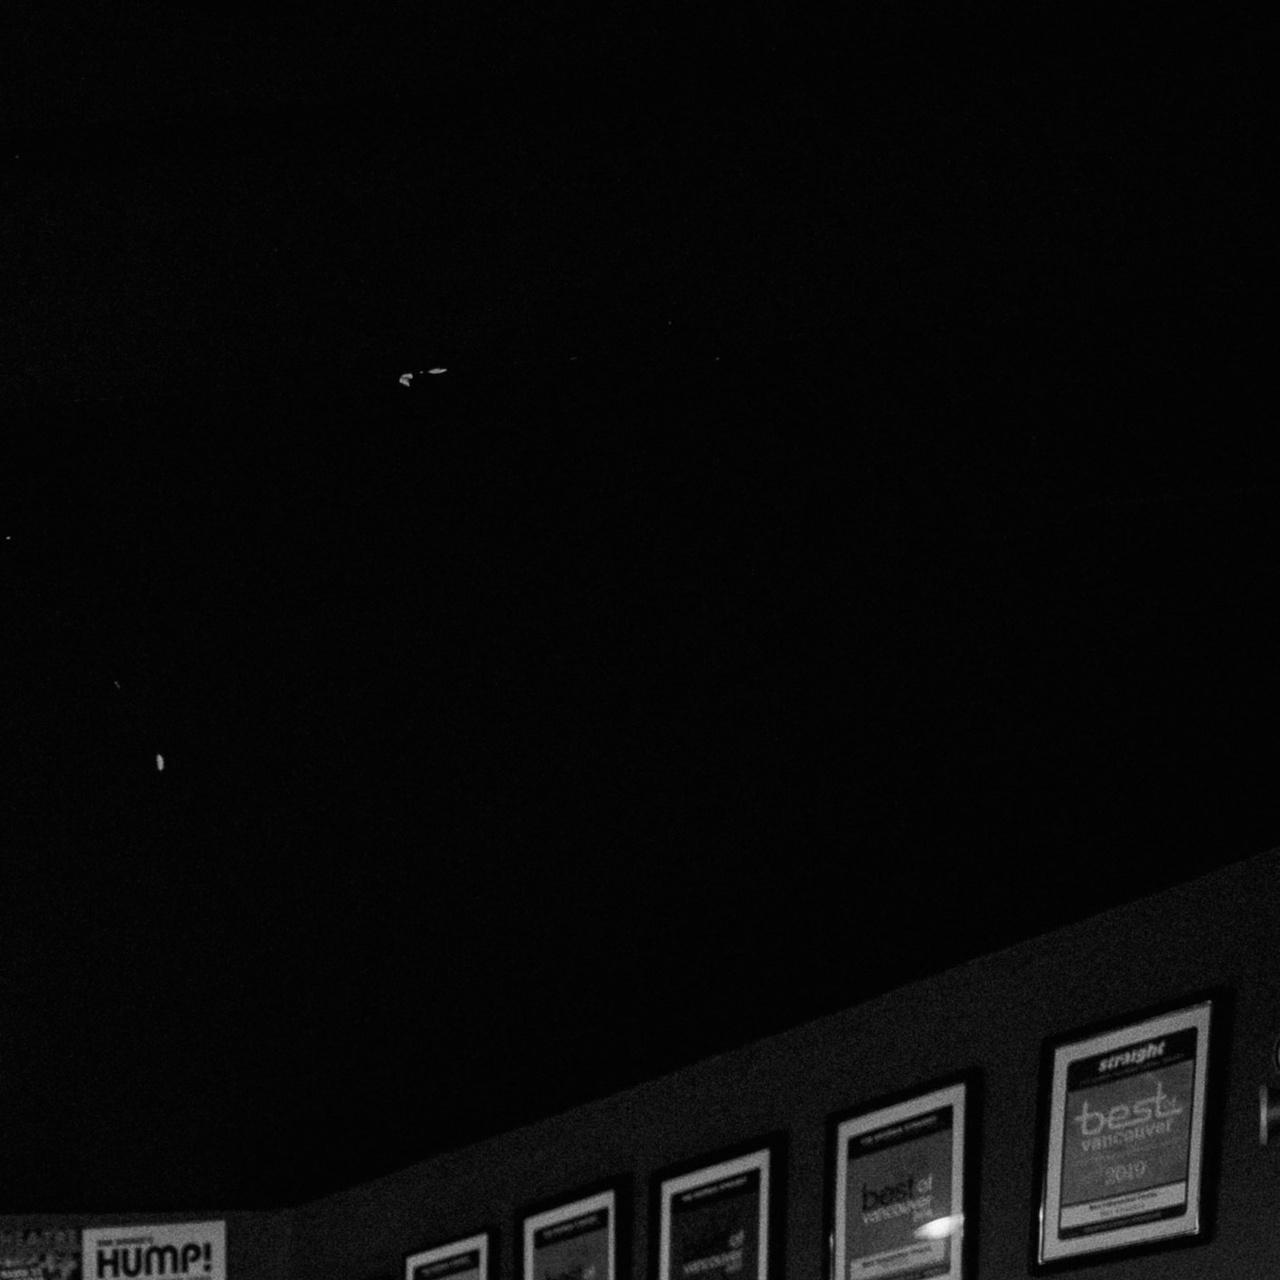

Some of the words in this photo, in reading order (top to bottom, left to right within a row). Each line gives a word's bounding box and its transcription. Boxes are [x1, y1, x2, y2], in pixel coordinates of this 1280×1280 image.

[1099, 1041, 1166, 1072] straight
[1074, 1081, 1183, 1136] best
[97, 1243, 210, 1278] HUMP!
